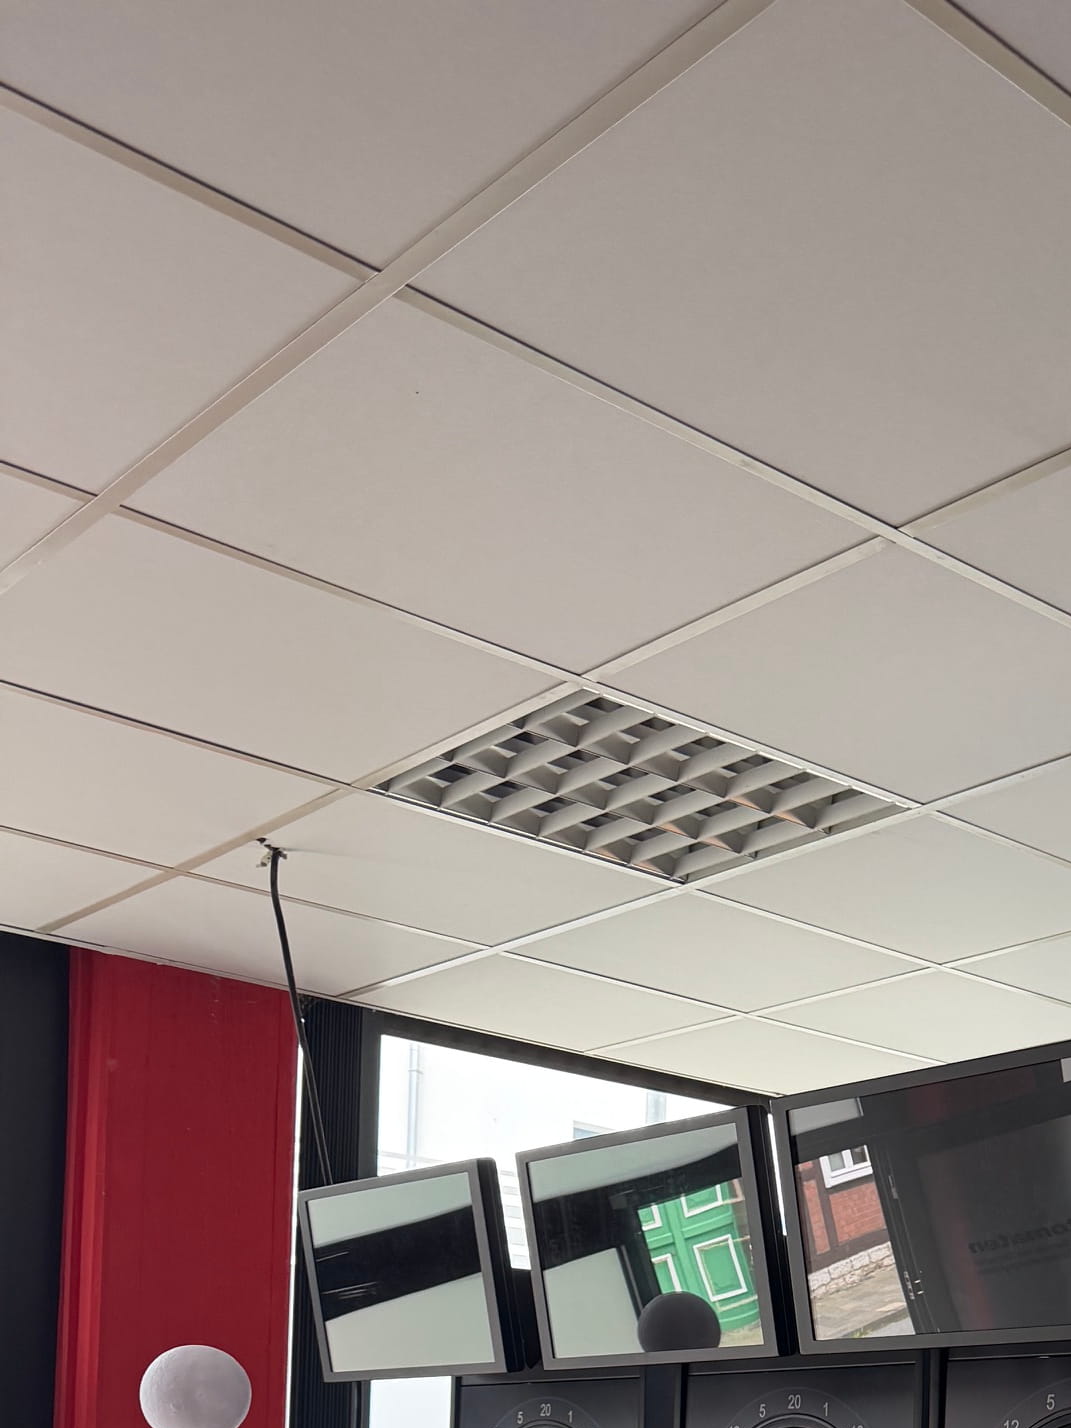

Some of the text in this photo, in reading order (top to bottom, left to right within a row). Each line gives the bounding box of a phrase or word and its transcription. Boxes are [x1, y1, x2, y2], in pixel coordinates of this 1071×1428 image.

[787, 1394, 801, 1410] 20
[823, 1402, 828, 1417] 1
[1046, 1393, 1055, 1411] 5
[539, 1403, 552, 1417] 20
[759, 1403, 766, 1418] 5
